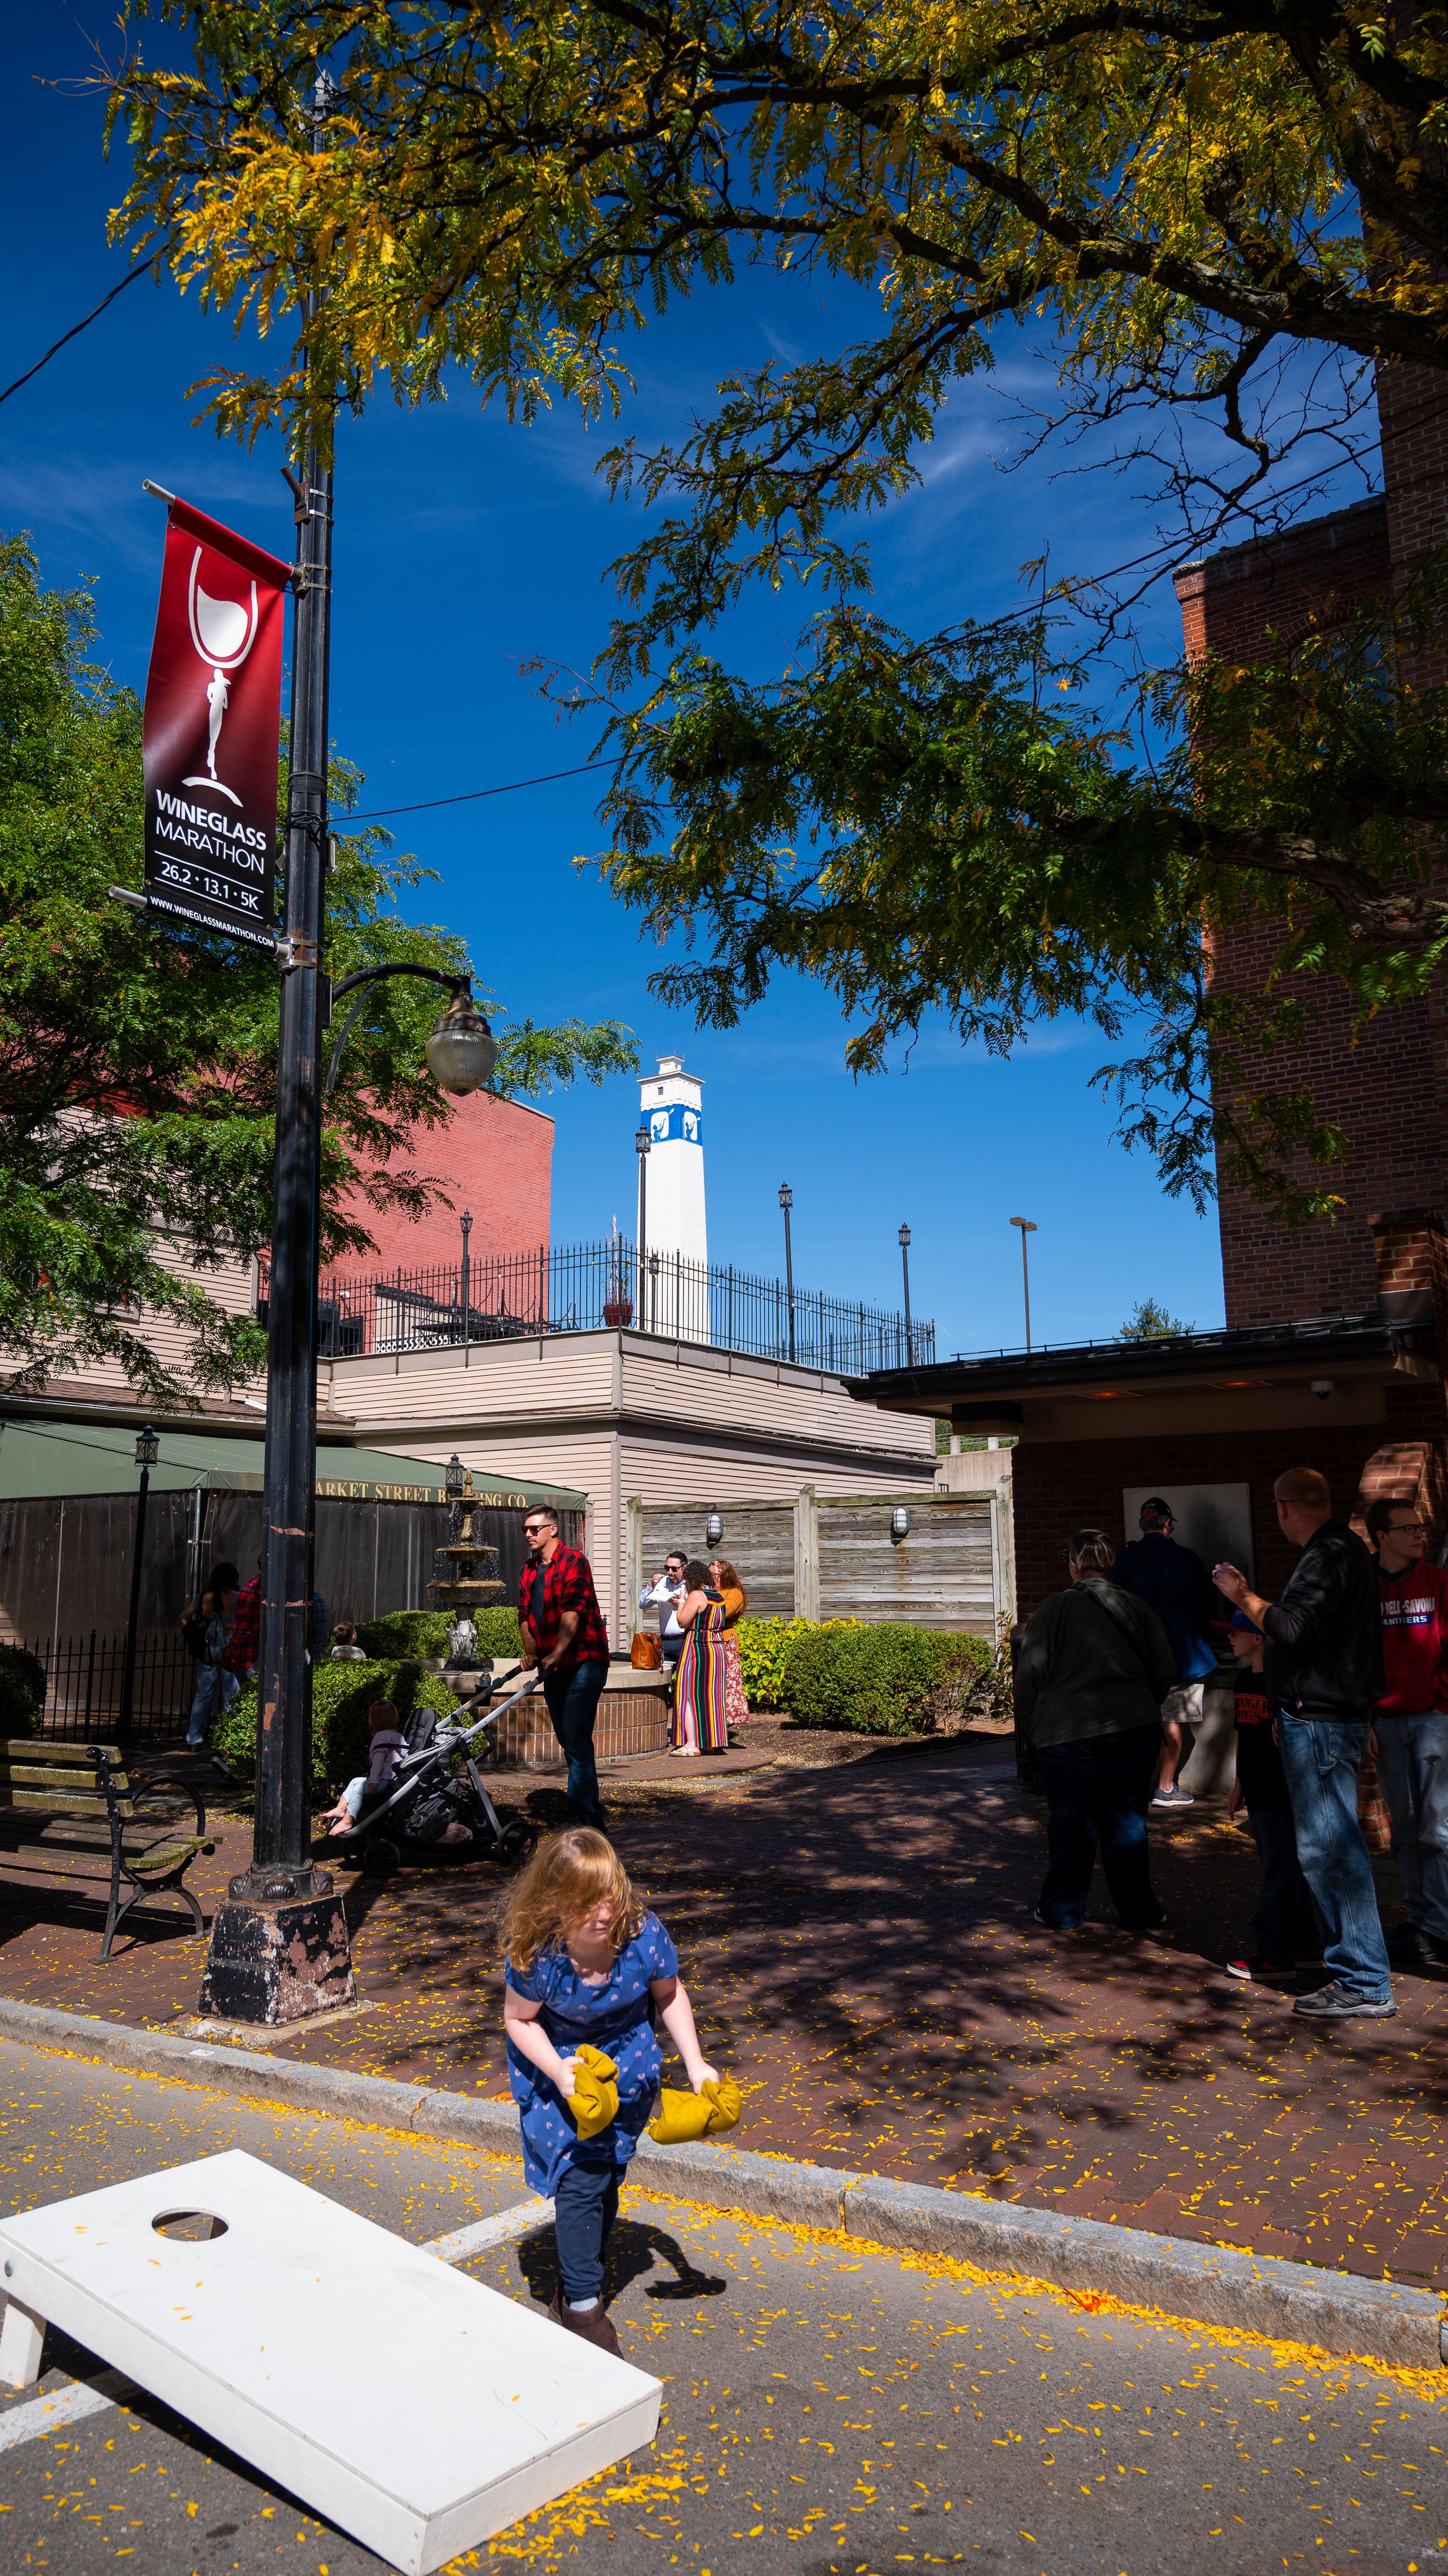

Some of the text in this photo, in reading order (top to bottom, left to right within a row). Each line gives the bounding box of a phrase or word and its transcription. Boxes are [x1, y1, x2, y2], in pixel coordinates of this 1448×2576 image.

[156, 788, 267, 850] WINEGLASS
[156, 816, 264, 875] MARATHON
[161, 861, 258, 911] 26.2 13.1 5K
[150, 896, 275, 948] WWW.WINEGLASSMARATHON.COM
[315, 1481, 529, 1508] ARKET STREET BING CO.
[1381, 1615, 1428, 1626] ANTHERS
